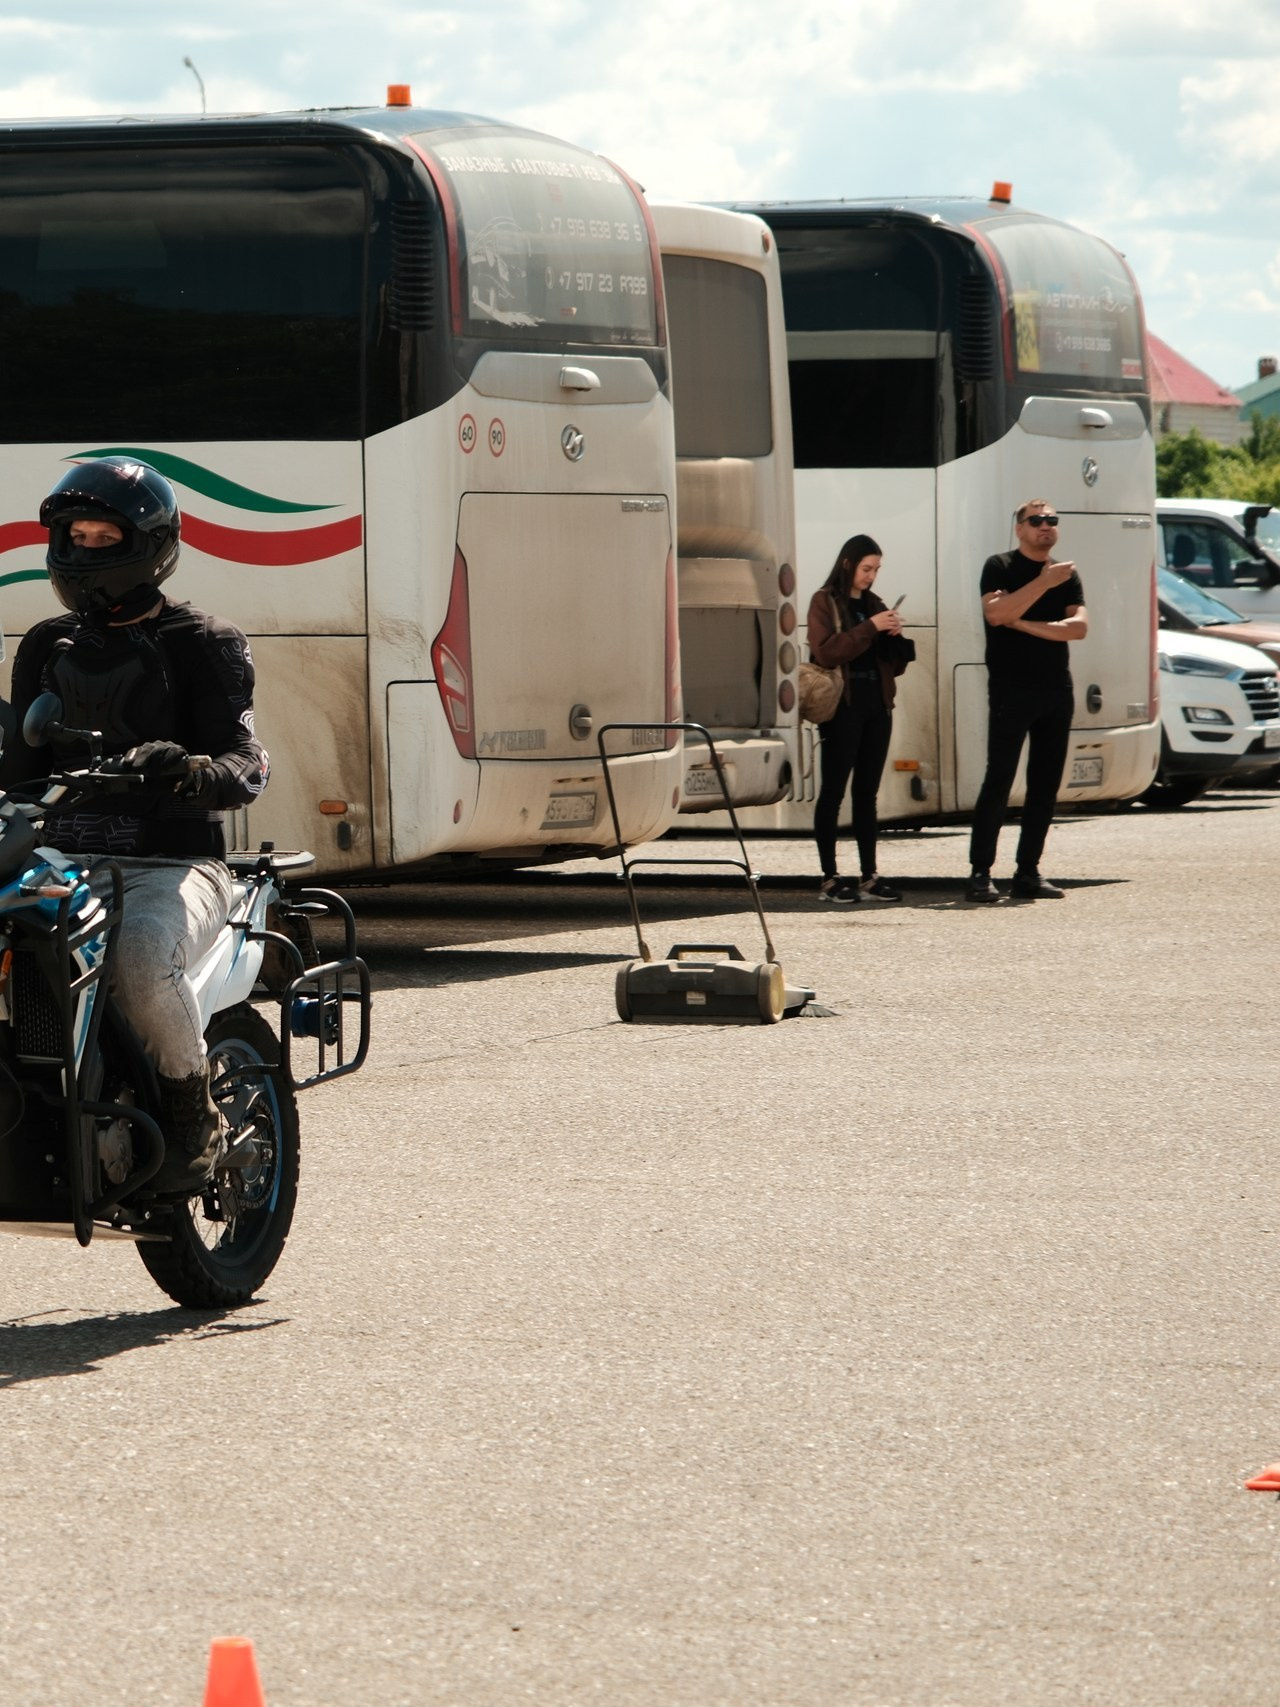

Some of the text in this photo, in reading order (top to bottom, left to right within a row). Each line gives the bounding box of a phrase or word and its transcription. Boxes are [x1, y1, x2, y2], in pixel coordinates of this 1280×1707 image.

[441, 156, 509, 173] ЗАКАЗНЫЕ
[576, 272, 594, 291] 917
[598, 273, 613, 292] 23
[462, 425, 473, 442] 60
[492, 429, 502, 445] 90
